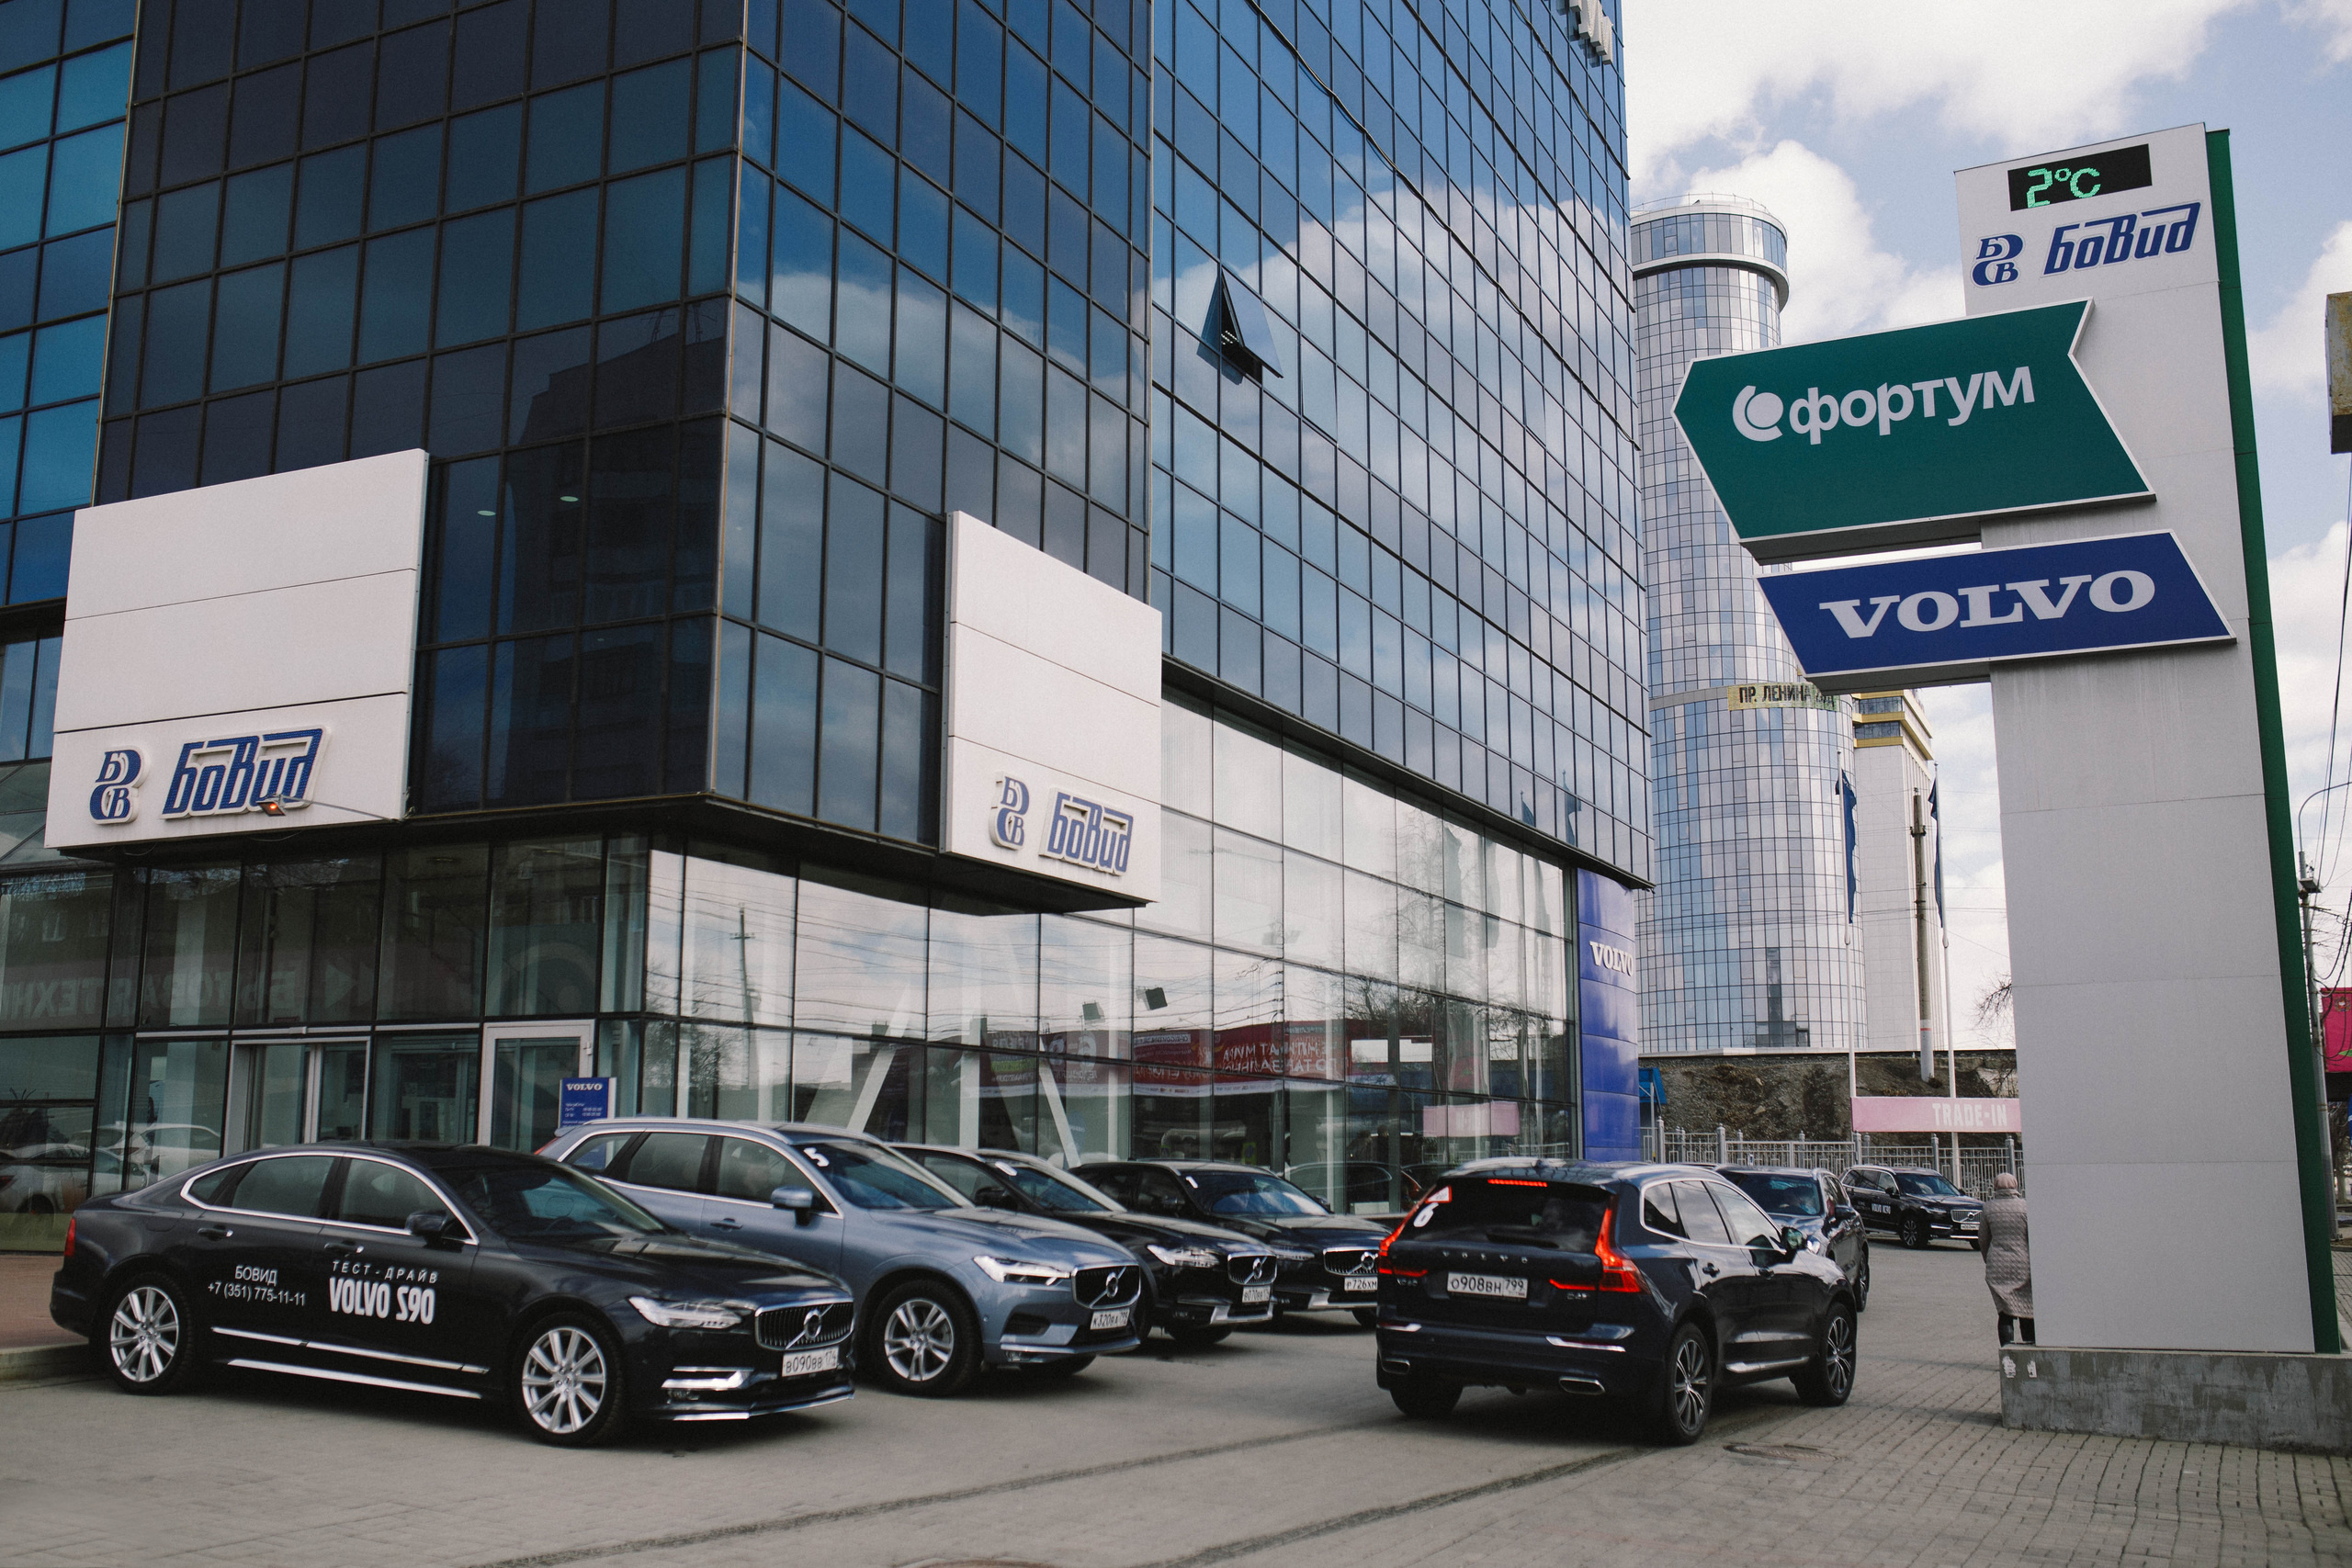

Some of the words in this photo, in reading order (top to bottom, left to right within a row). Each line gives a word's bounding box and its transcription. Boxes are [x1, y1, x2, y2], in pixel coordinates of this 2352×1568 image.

[1789, 366, 2035, 446] фортум
[1819, 570, 2155, 638] VOLVO
[1739, 687, 1757, 704] ПР.
[1762, 685, 1811, 703] ЛЕНИНА
[1589, 941, 1634, 976] VOLVO
[566, 1083, 603, 1091] VOLVO
[1932, 1102, 2007, 1127] TRADE-IN
[1413, 1202, 1439, 1227] 6
[234, 1265, 277, 1286] БОВИД
[208, 1281, 221, 1294] +7
[223, 1283, 252, 1302] (351)
[254, 1287, 306, 1306] 775-11-11
[329, 1277, 390, 1319] VOLVO
[395, 1286, 435, 1325] S90
